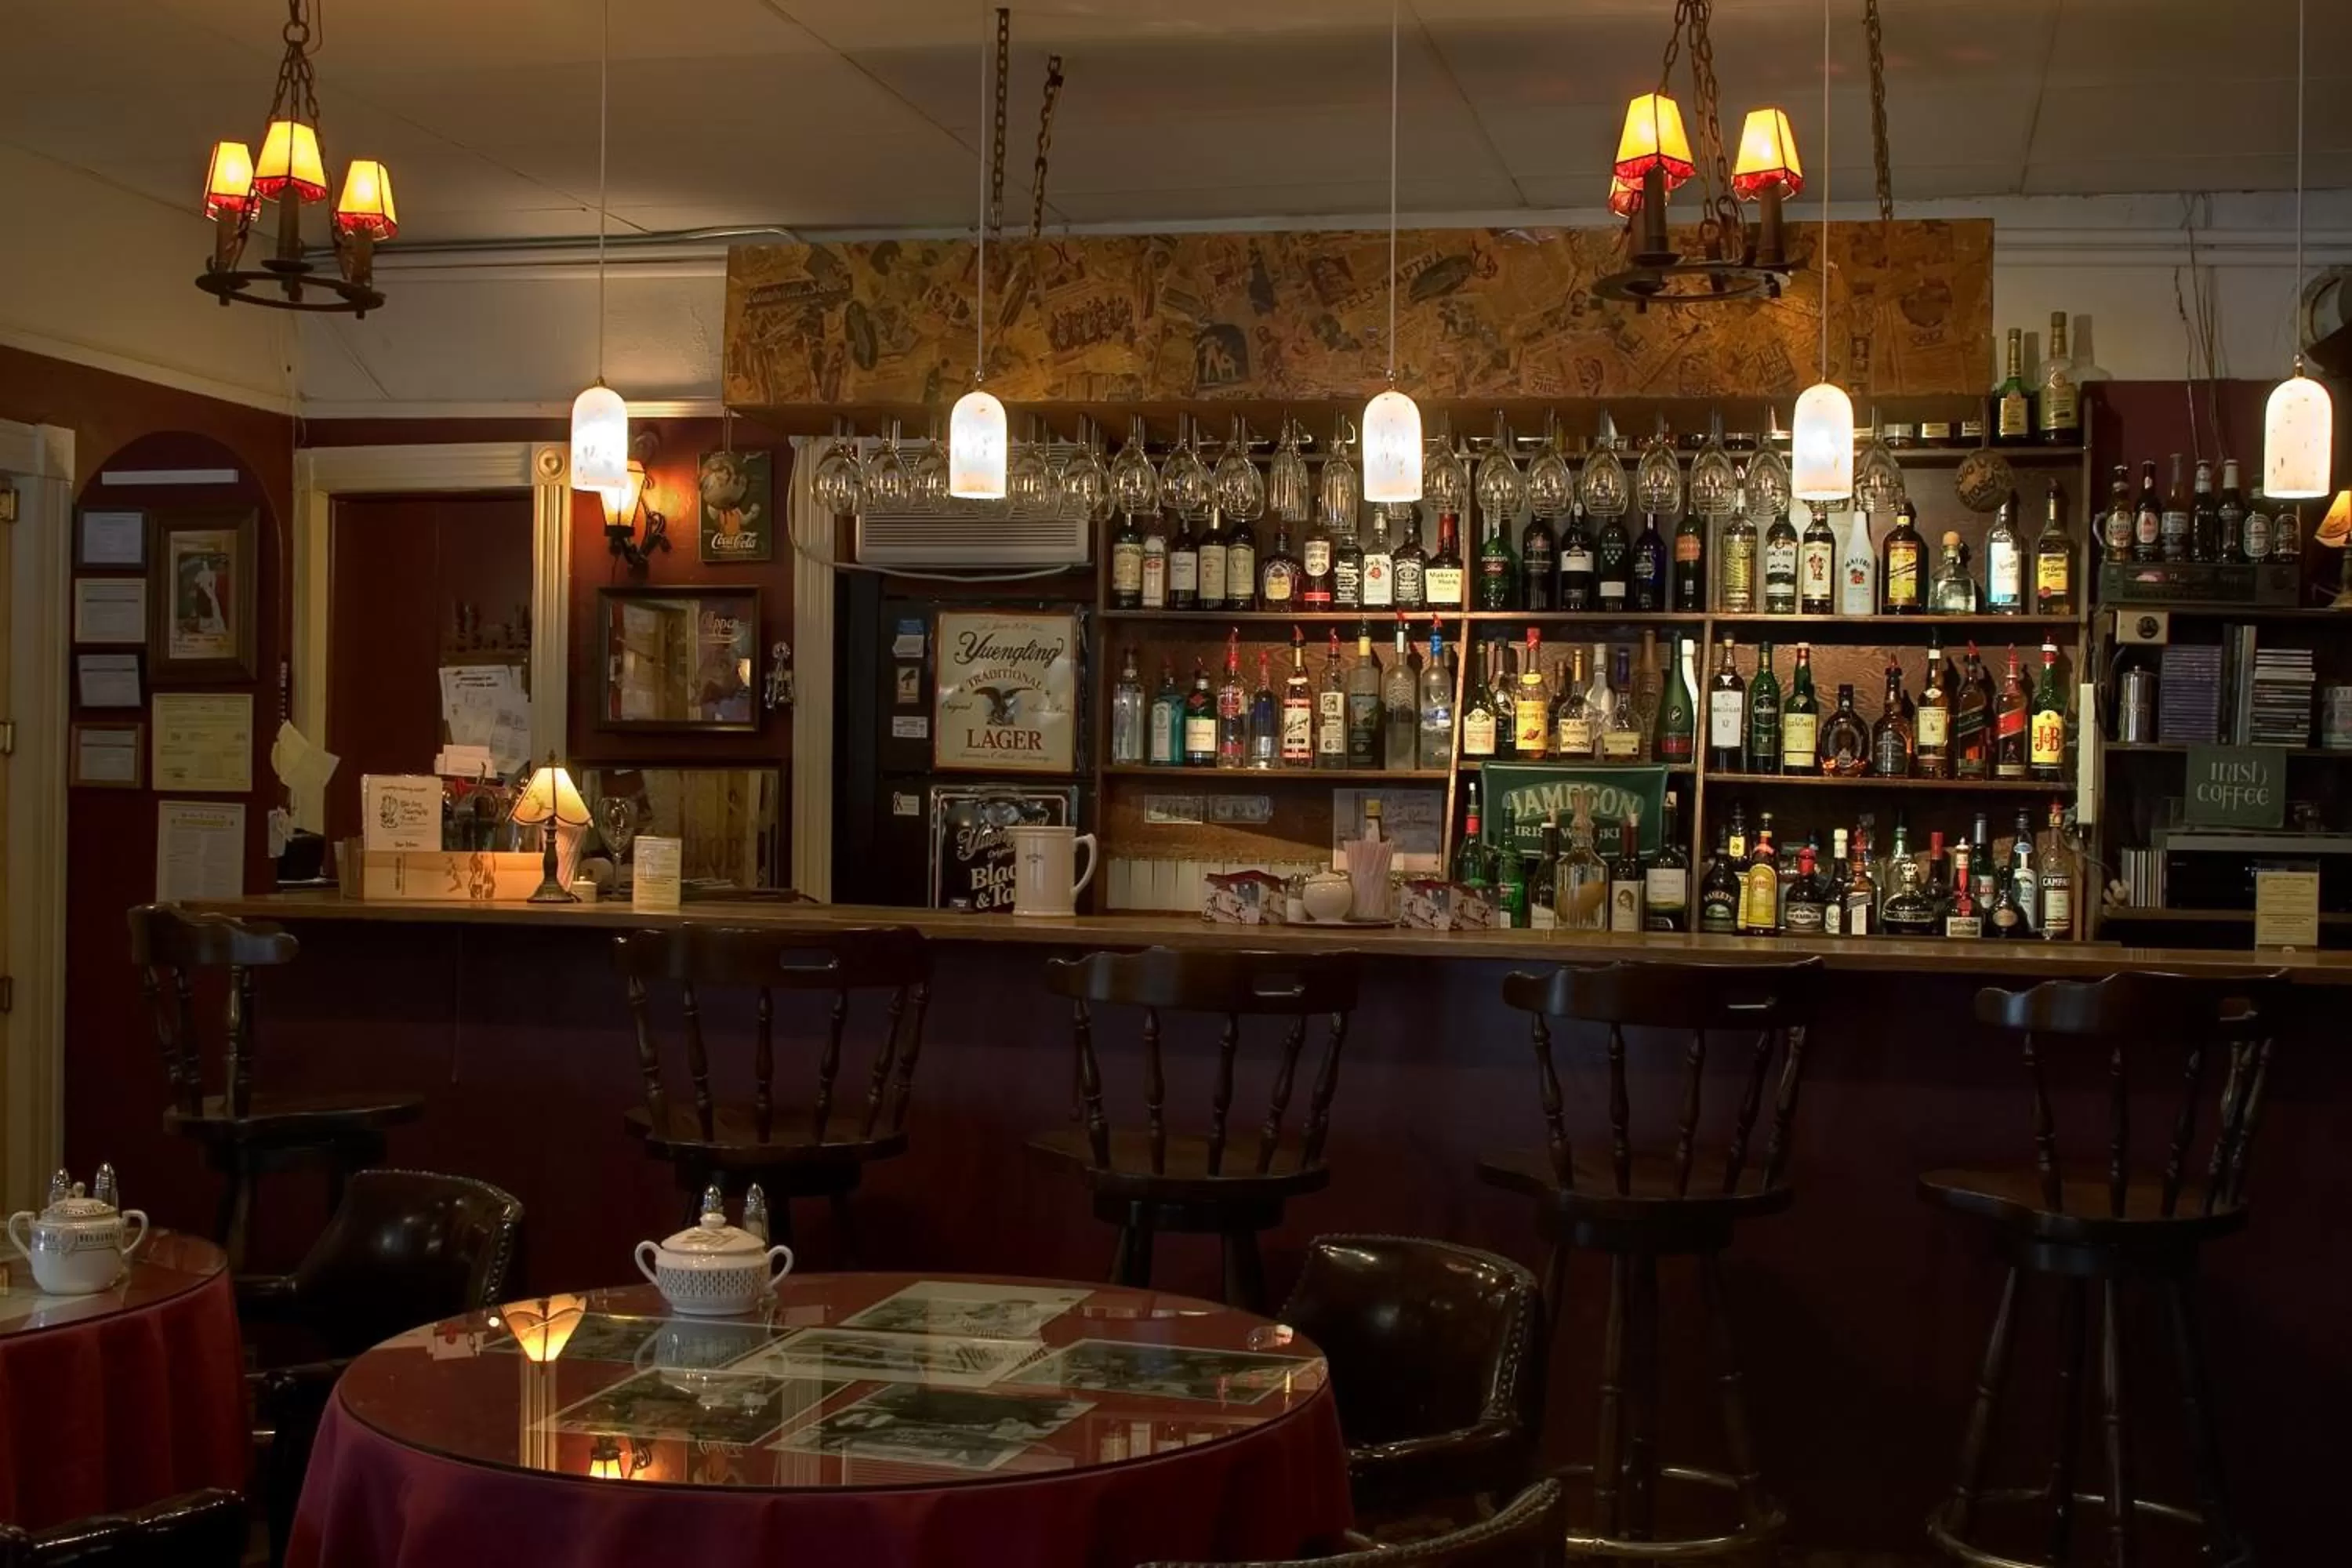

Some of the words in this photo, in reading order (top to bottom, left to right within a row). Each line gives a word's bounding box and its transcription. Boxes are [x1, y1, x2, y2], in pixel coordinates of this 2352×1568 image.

[954, 631, 1064, 668] Yuengling
[966, 668, 1042, 690] TRADITIONAL
[966, 728, 1042, 750] LAGER
[2196, 782, 2270, 811] COFFEE
